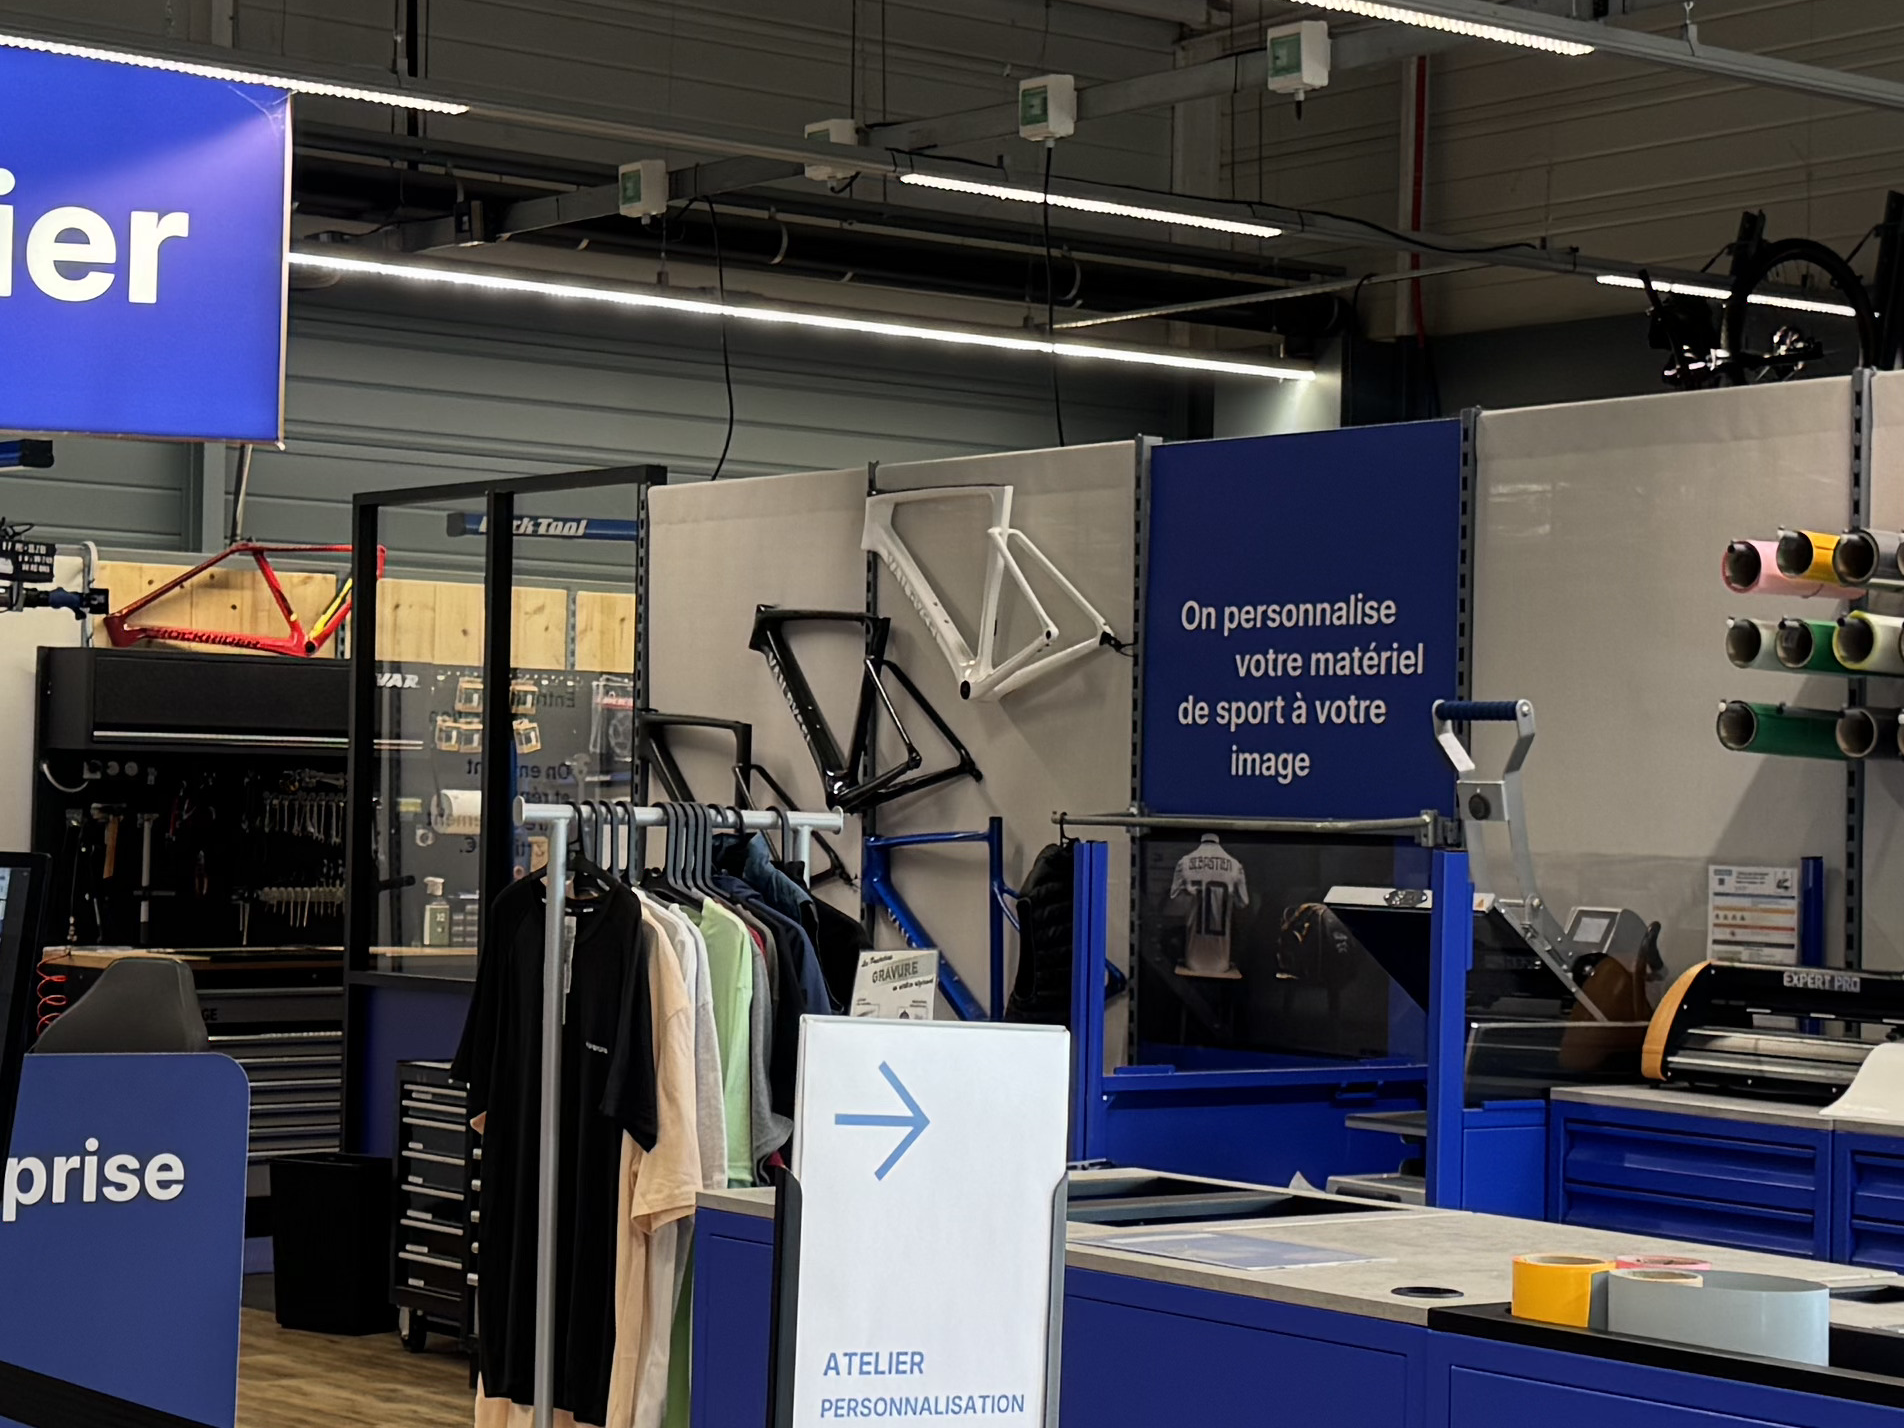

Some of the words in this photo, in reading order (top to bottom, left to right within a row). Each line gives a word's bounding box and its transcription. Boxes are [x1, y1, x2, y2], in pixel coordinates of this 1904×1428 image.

[479, 515, 537, 534] Prk
[537, 519, 589, 537] Tool
[1181, 600, 1216, 631] On
[1223, 593, 1397, 637] personnalise
[1235, 647, 1303, 678] votre
[1309, 642, 1425, 677] matériel
[1178, 695, 1209, 724] de
[1216, 695, 1285, 732] sport
[1292, 690, 1307, 724] à
[1315, 694, 1387, 724] votre
[1231, 745, 1310, 785] image
[872, 961, 919, 984] GRAVURE
[1783, 971, 1832, 990] EXPERT
[1833, 974, 1861, 993] PRO
[200, 1007, 219, 1022] GE
[2, 1137, 185, 1222] prise
[822, 1350, 925, 1377] ATELIER
[820, 1393, 1026, 1420] PERSONNALISATION
